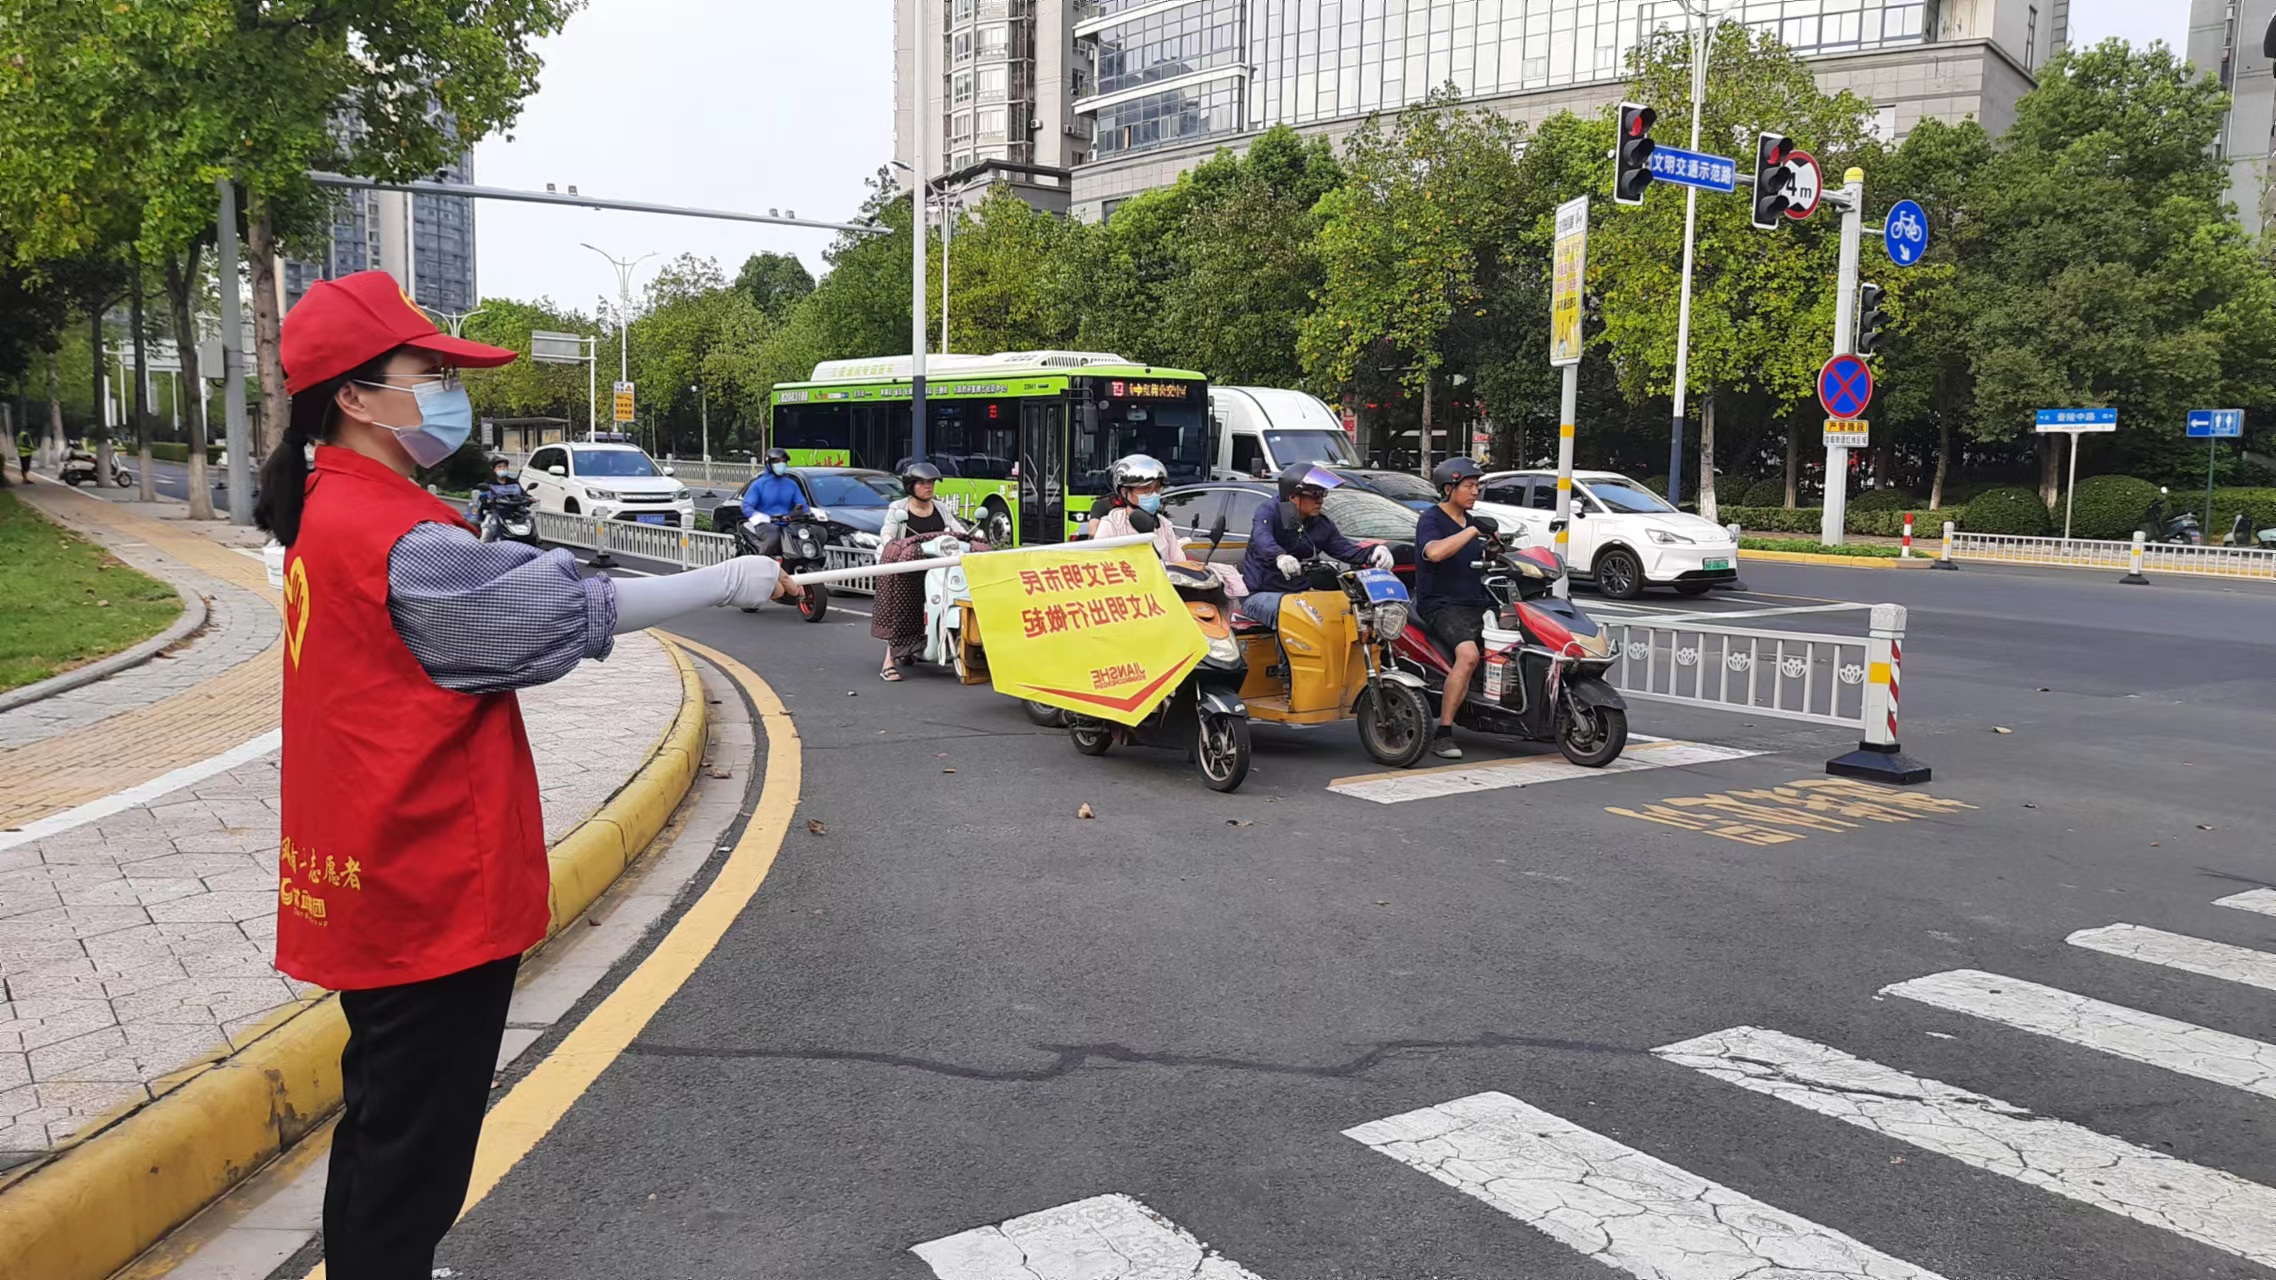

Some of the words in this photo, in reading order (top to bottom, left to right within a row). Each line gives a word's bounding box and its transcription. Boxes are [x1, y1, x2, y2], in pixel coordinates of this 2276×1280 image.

[1653, 153, 1732, 185] 文明交通示范路
